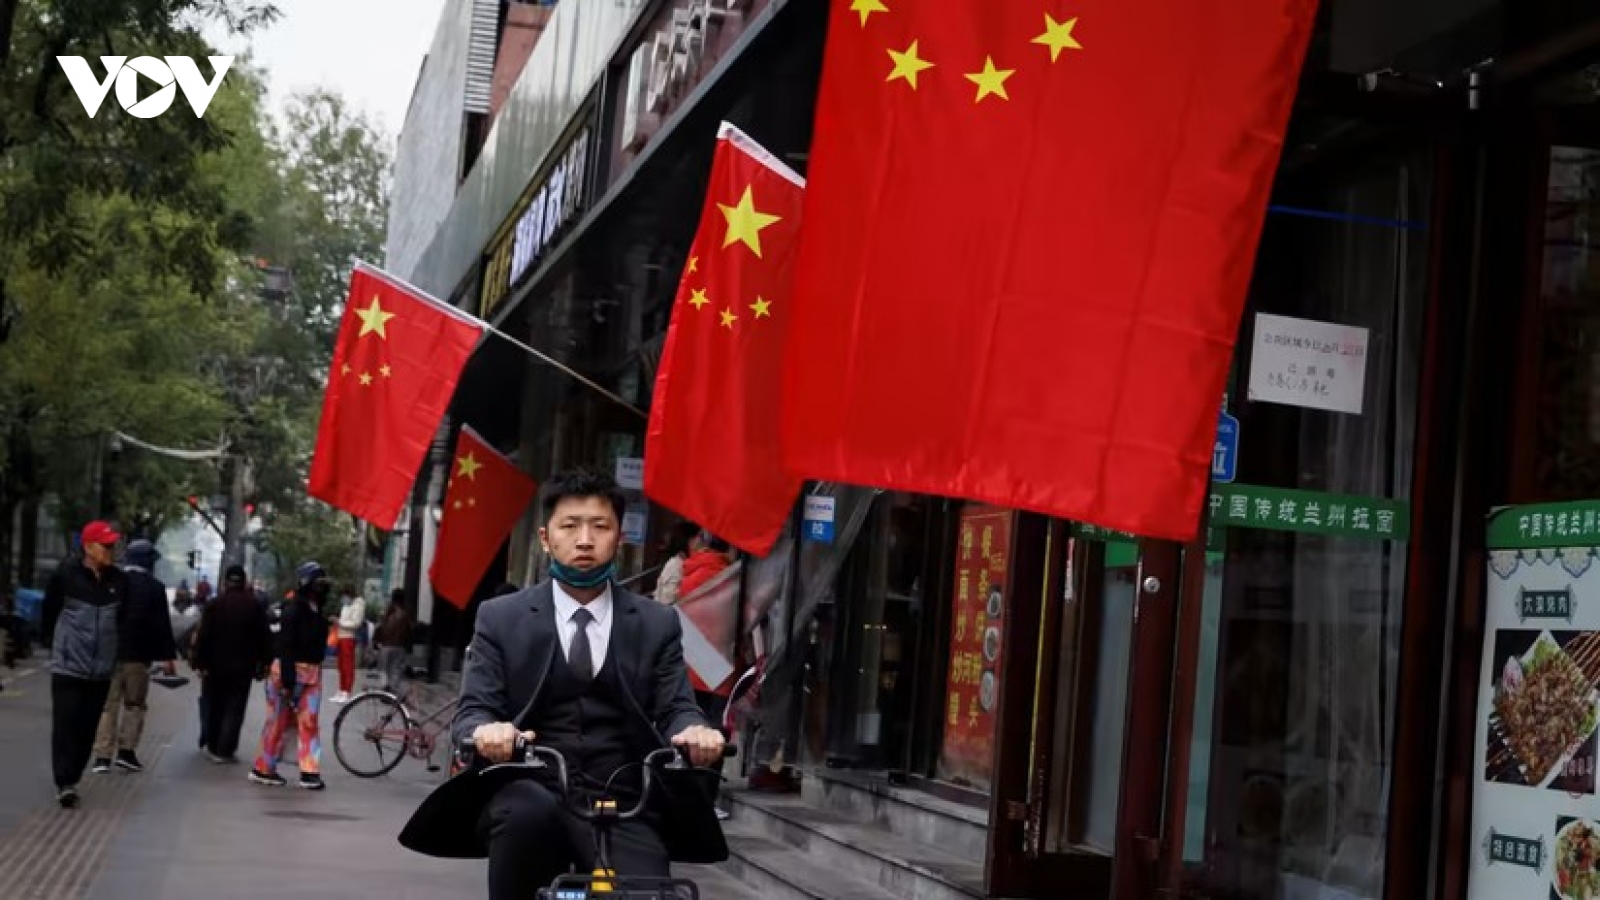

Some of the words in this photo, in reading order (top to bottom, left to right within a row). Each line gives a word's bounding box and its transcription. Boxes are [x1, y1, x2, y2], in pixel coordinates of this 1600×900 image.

[1209, 494, 1395, 533] 中国传统兰州拉面
[1519, 509, 1600, 539] 中国传统兰州
